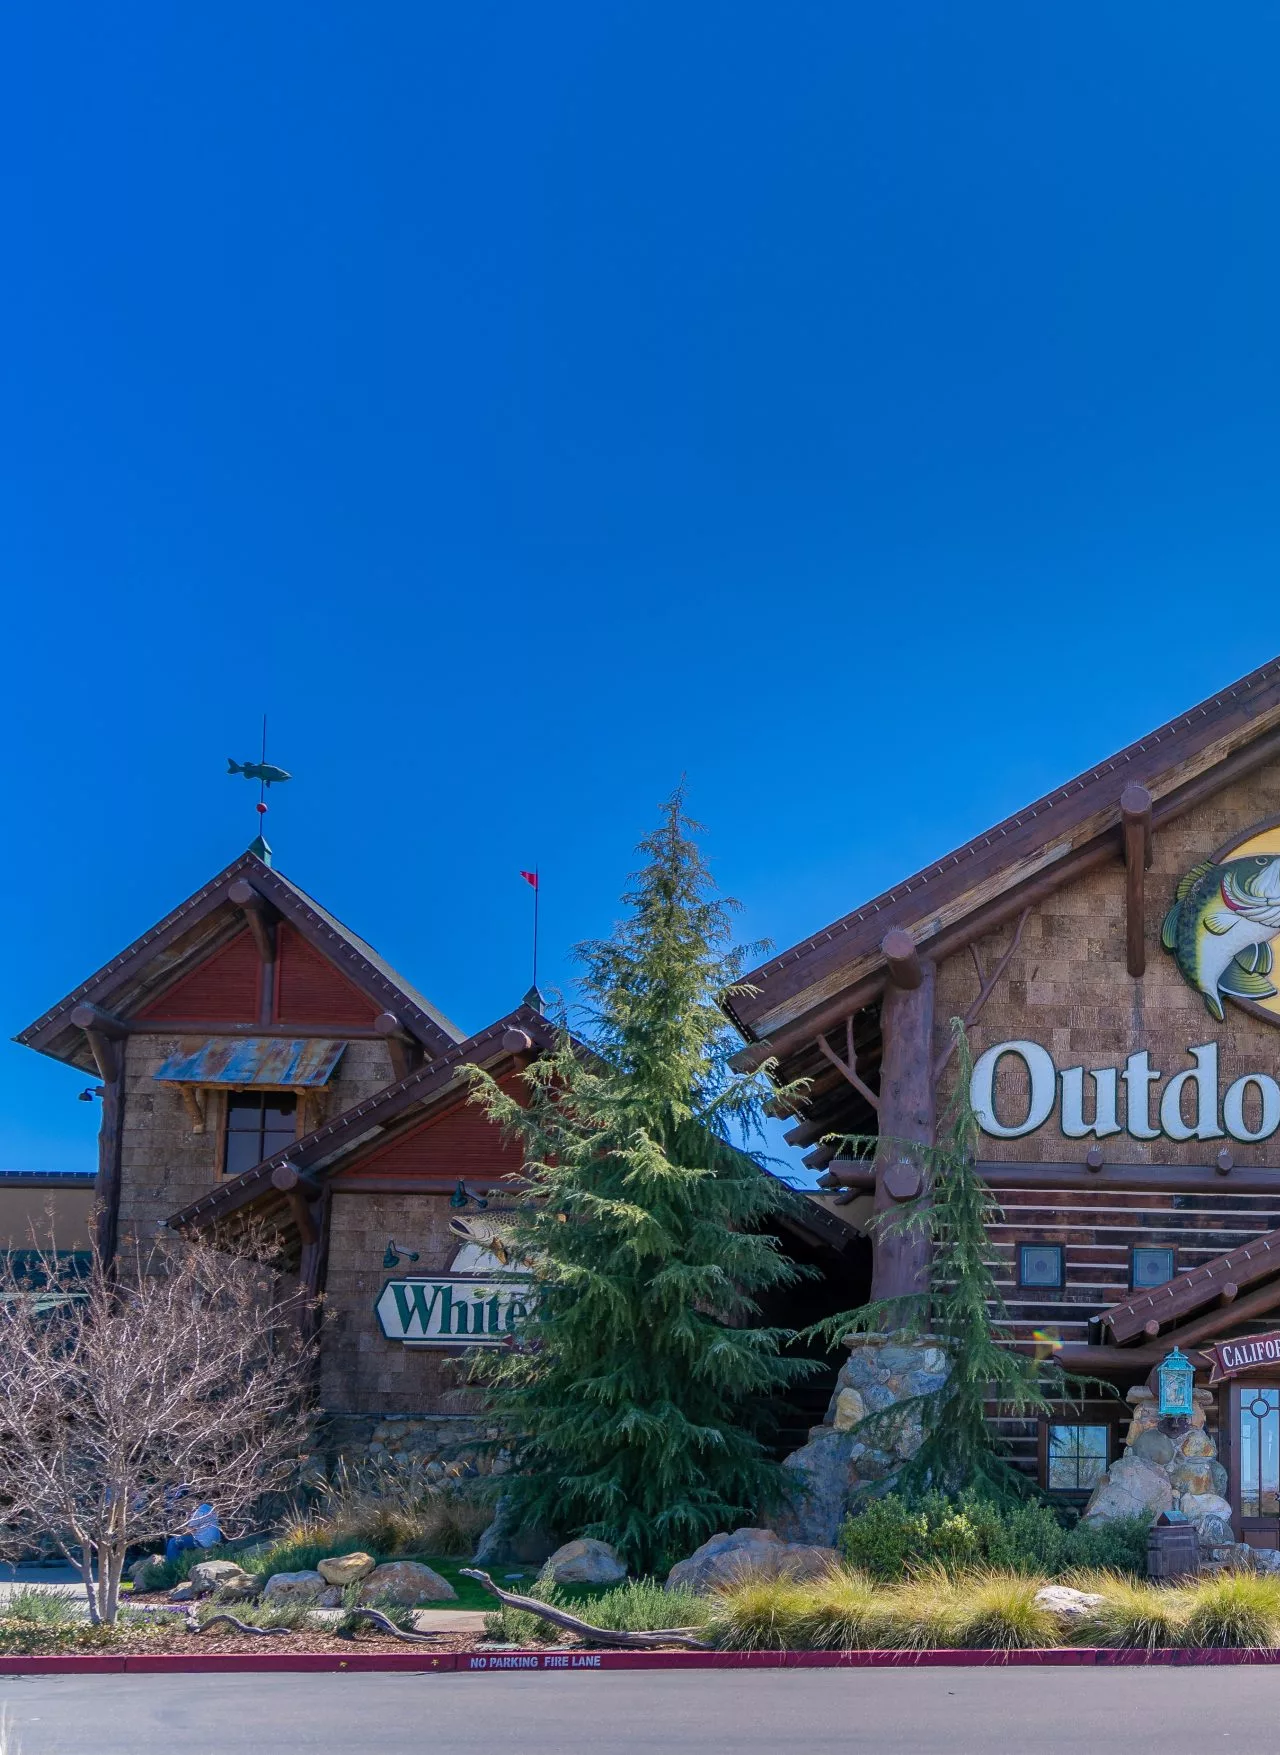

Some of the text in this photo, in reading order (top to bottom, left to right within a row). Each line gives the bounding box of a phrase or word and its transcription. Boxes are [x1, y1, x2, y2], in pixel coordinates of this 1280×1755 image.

[390, 1284, 528, 1335] White
[470, 1655, 601, 1668] NO PARKING FIRE LANE
